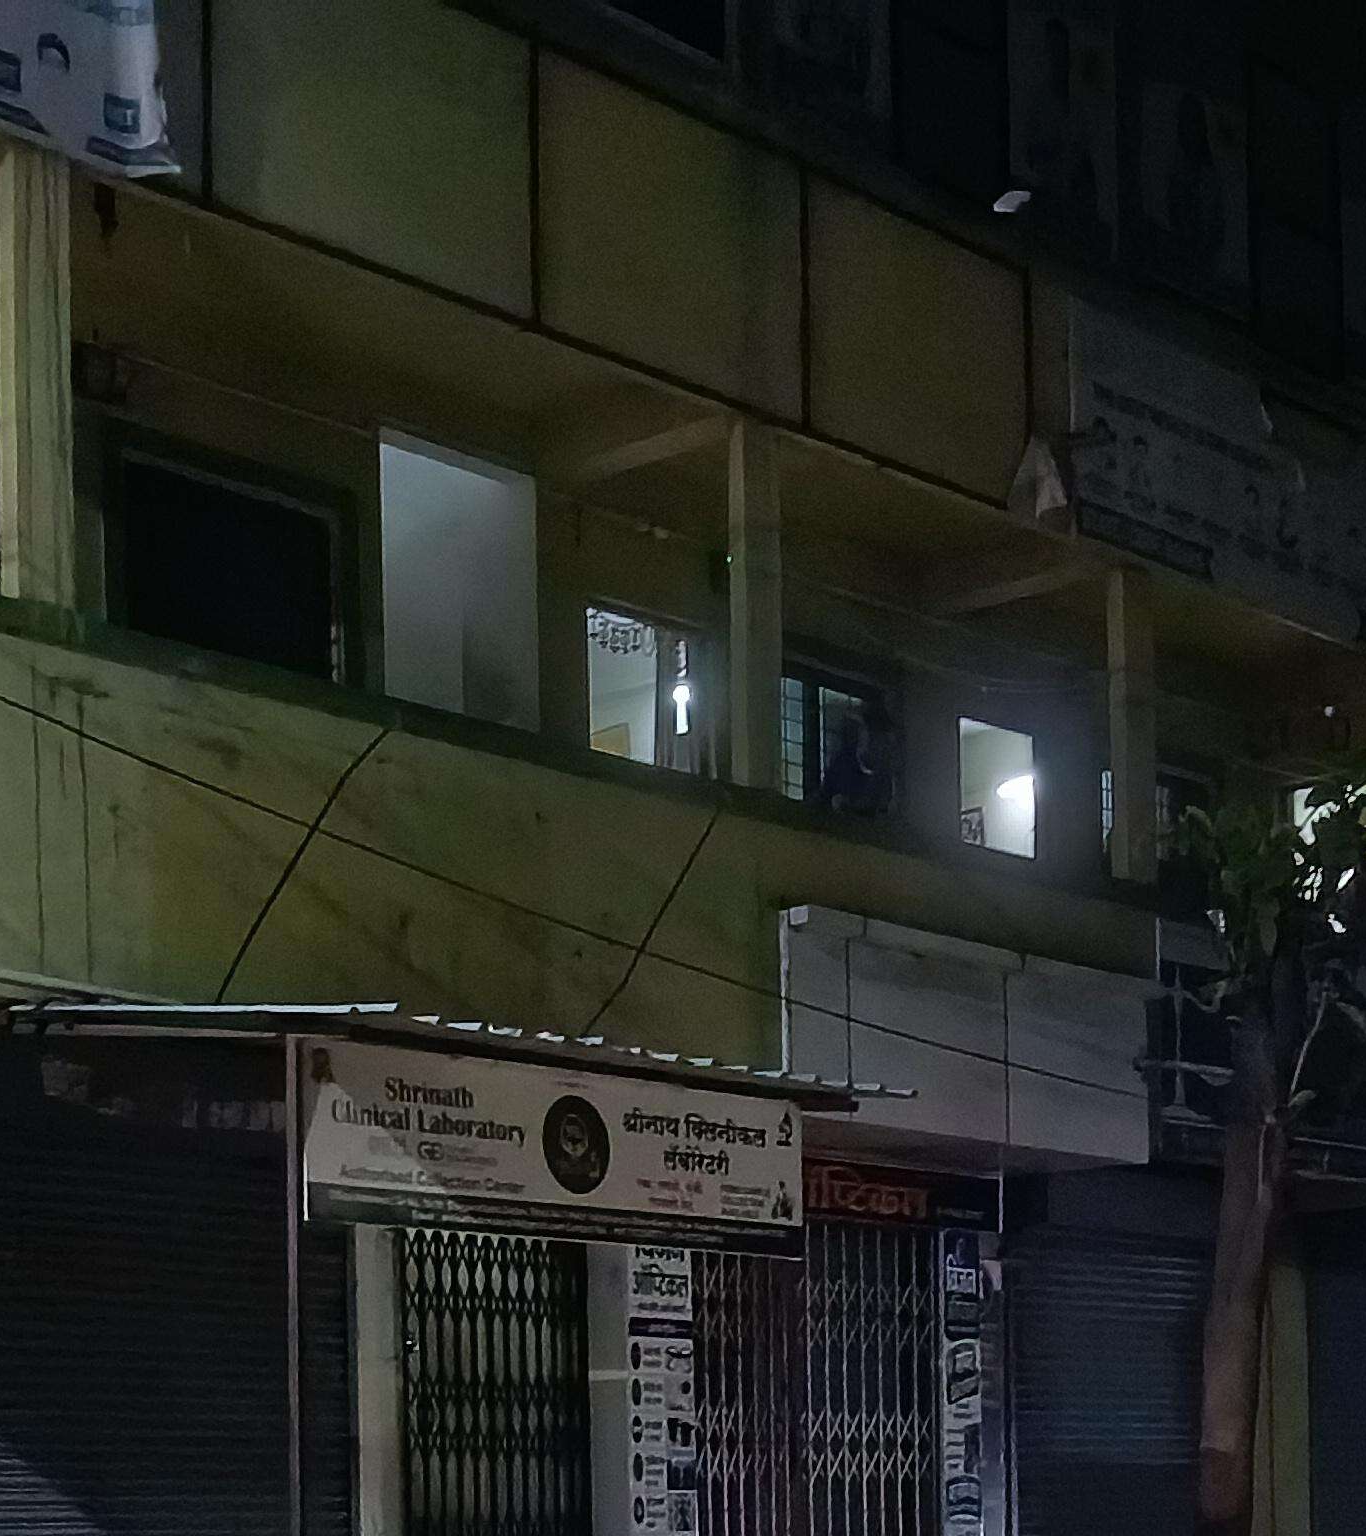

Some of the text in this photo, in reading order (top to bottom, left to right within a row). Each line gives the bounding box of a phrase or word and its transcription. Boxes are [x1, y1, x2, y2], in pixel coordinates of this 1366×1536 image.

[384, 1076, 475, 1108] Shrinath
[331, 1098, 525, 1148] Clinical Laboratory
